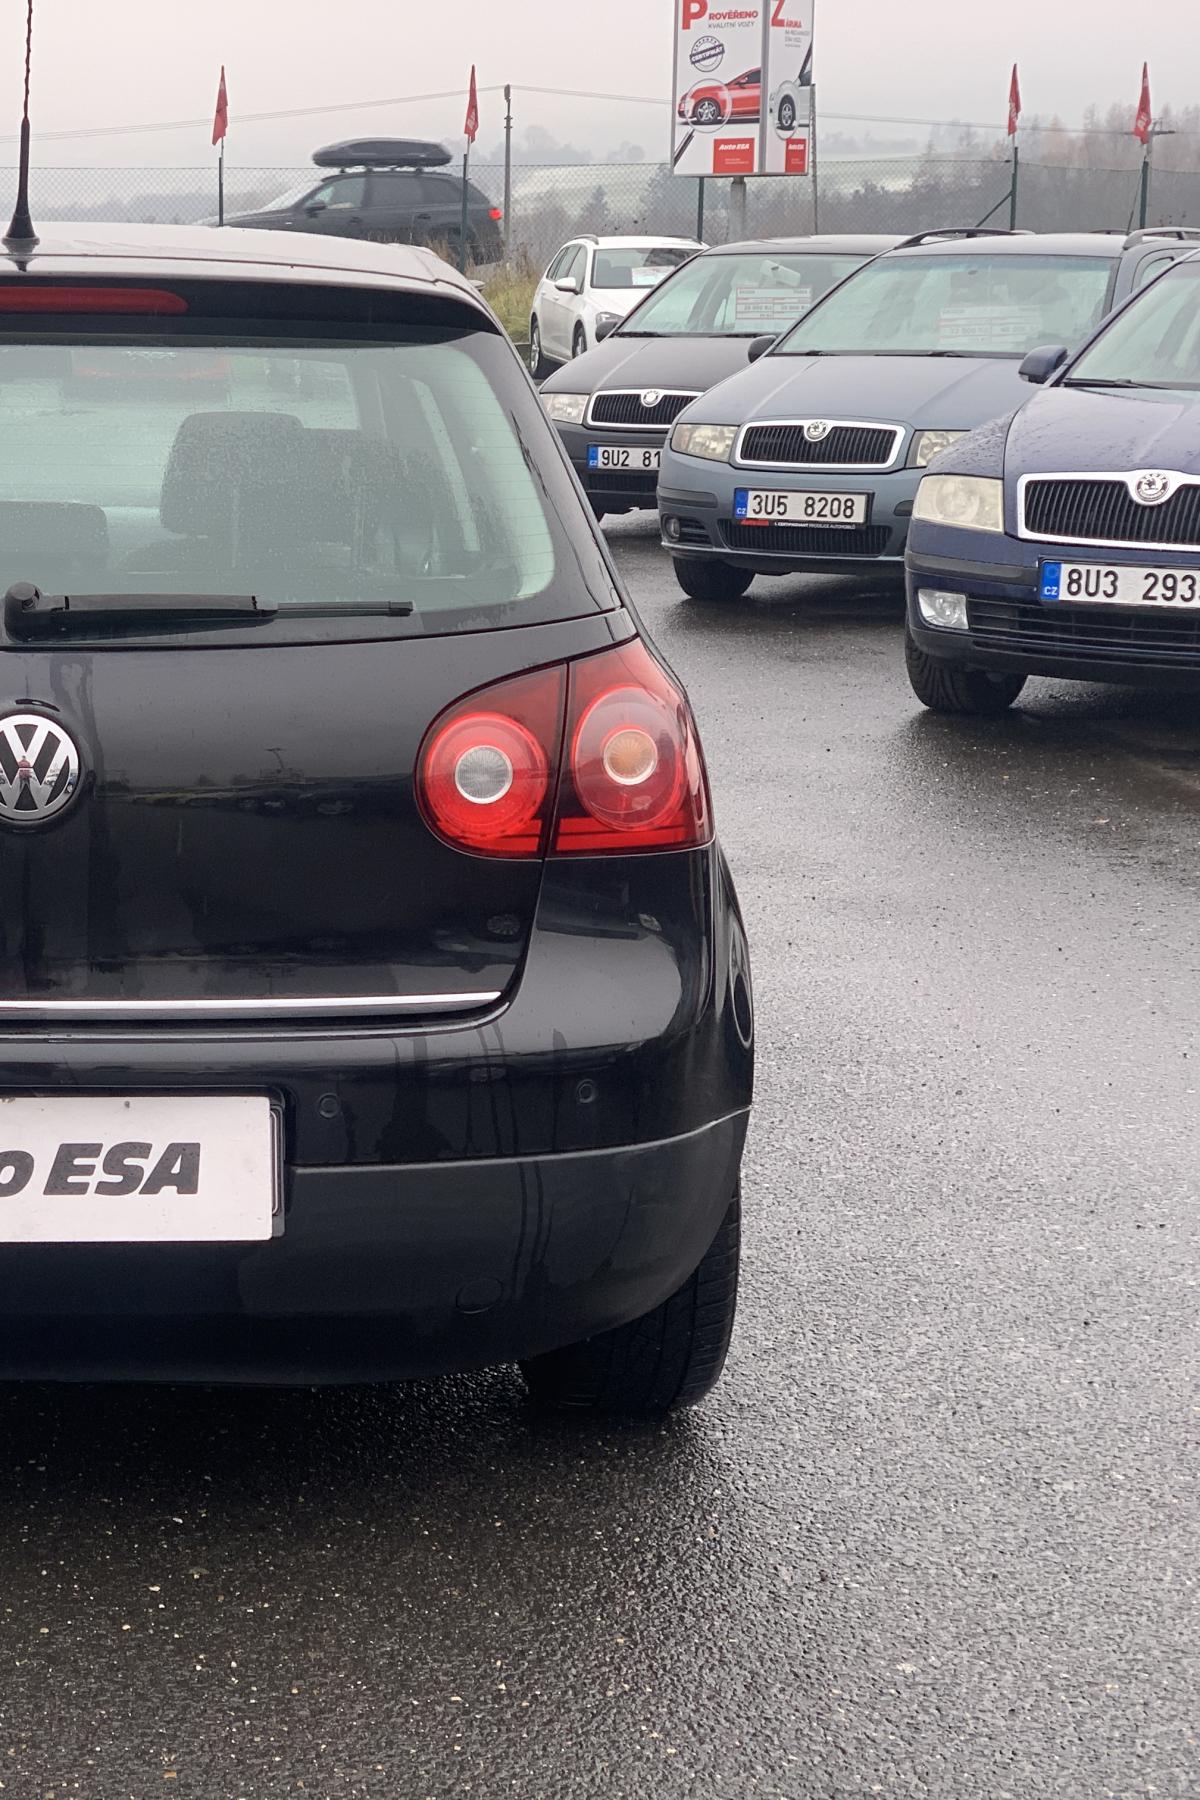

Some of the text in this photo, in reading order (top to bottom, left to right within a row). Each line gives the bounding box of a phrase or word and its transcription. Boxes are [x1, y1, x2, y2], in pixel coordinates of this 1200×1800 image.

[601, 449, 630, 467] 9U2
[642, 450, 661, 468] 81
[752, 494, 789, 516] 3U5
[804, 496, 855, 519] 8208
[1044, 568, 1200, 602] CZ 8U3 293
[43, 1142, 201, 1196] ESA
